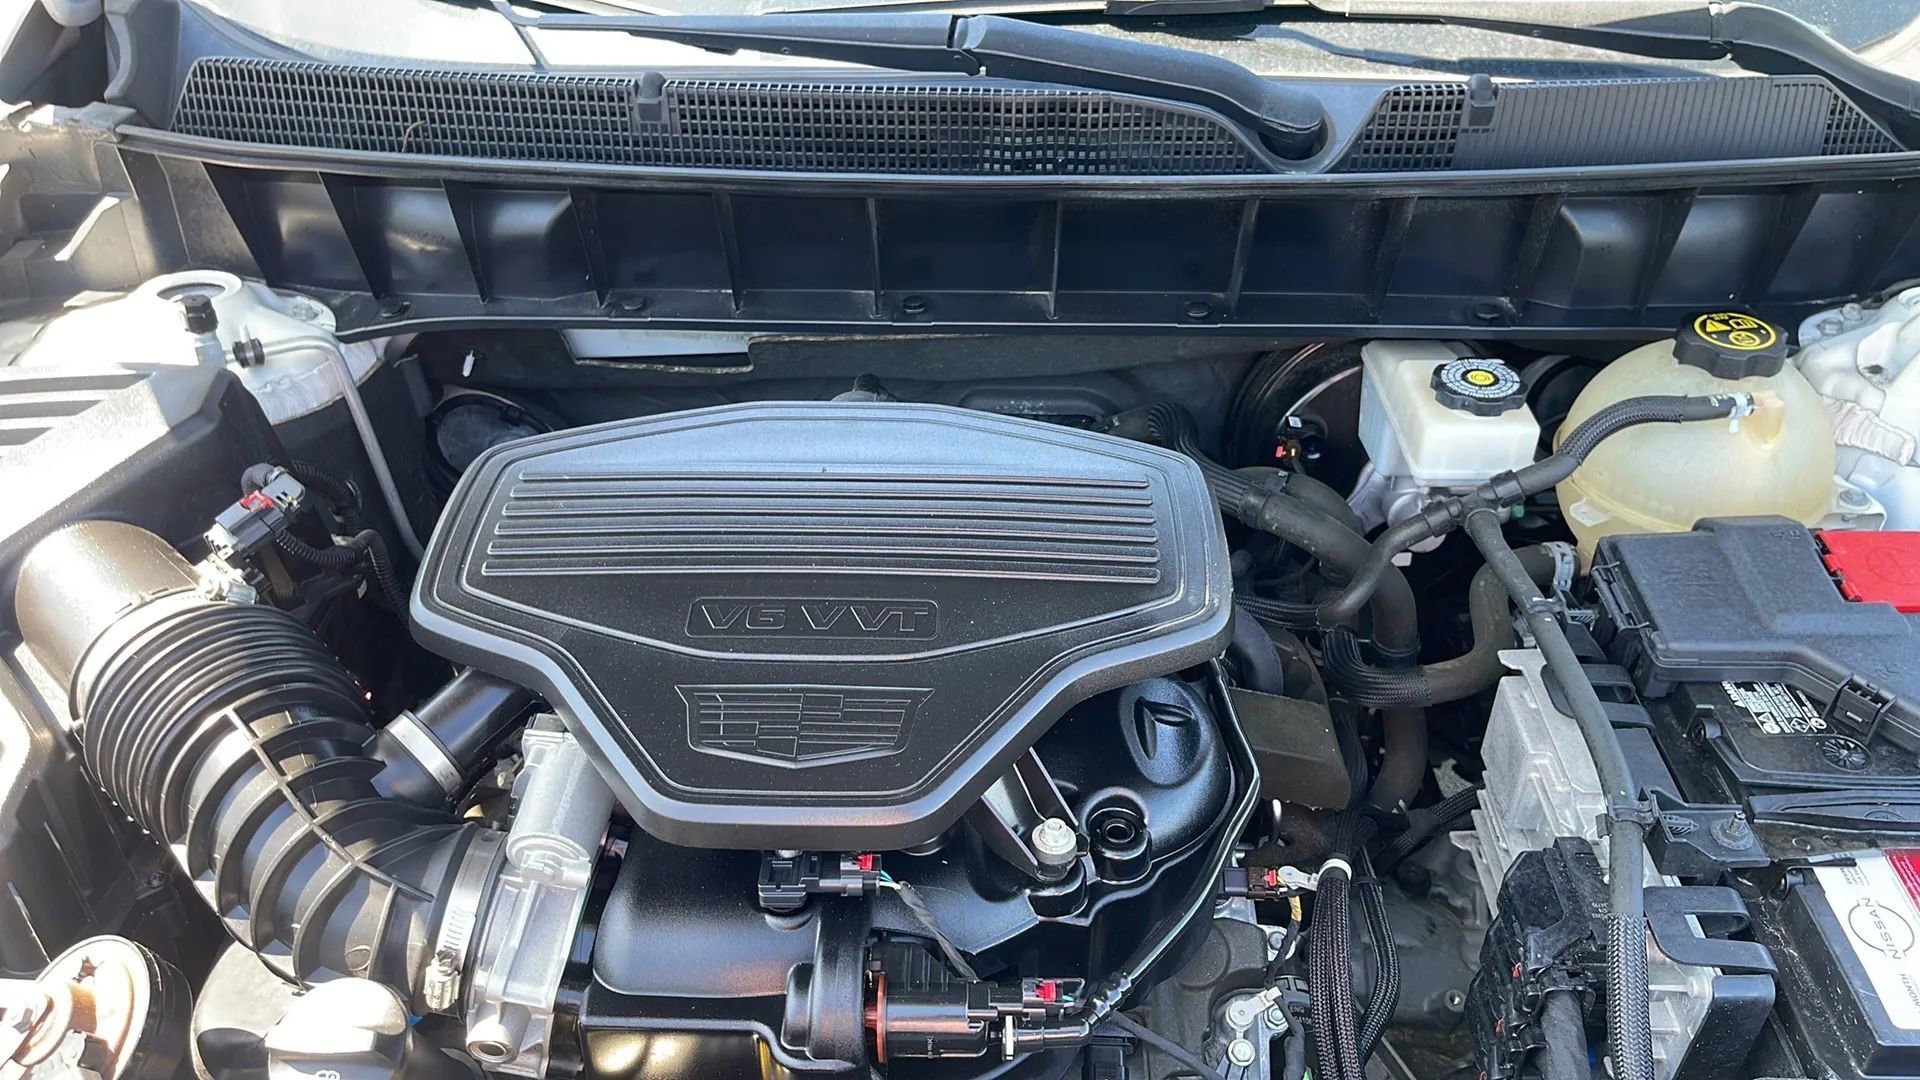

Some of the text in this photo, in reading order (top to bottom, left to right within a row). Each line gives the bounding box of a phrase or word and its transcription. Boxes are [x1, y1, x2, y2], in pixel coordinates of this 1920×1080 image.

[701, 603, 930, 632] V6 VVT
[1861, 897, 1902, 960] NISSAN
[1898, 972, 1920, 1007] MONTH
